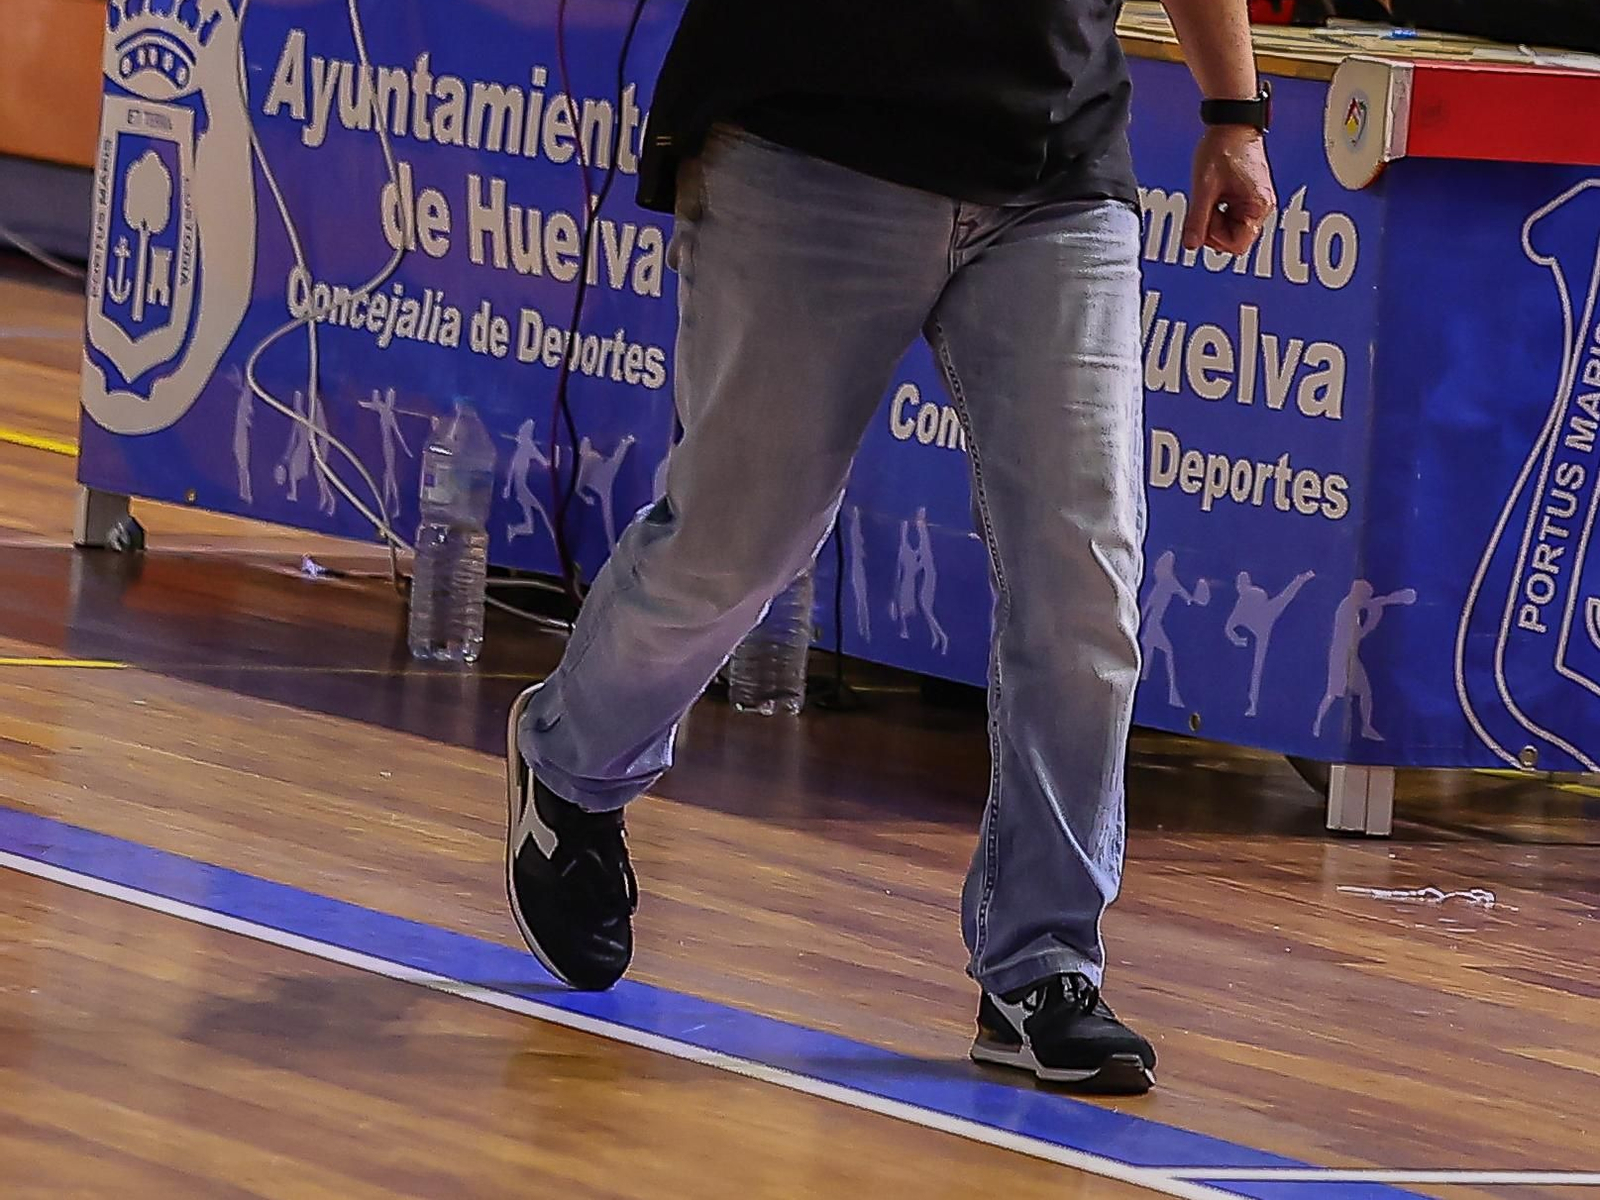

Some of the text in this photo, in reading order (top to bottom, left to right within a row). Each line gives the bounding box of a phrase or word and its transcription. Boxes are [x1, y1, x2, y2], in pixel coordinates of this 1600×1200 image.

[262, 28, 649, 174] Ayuntamient
[381, 161, 665, 298] de Huelva
[286, 263, 462, 350] Concejalía
[470, 301, 511, 359] de
[890, 383, 966, 452] Con
[1149, 428, 1350, 520] Deportes
[1517, 462, 1587, 634] PORTUS
